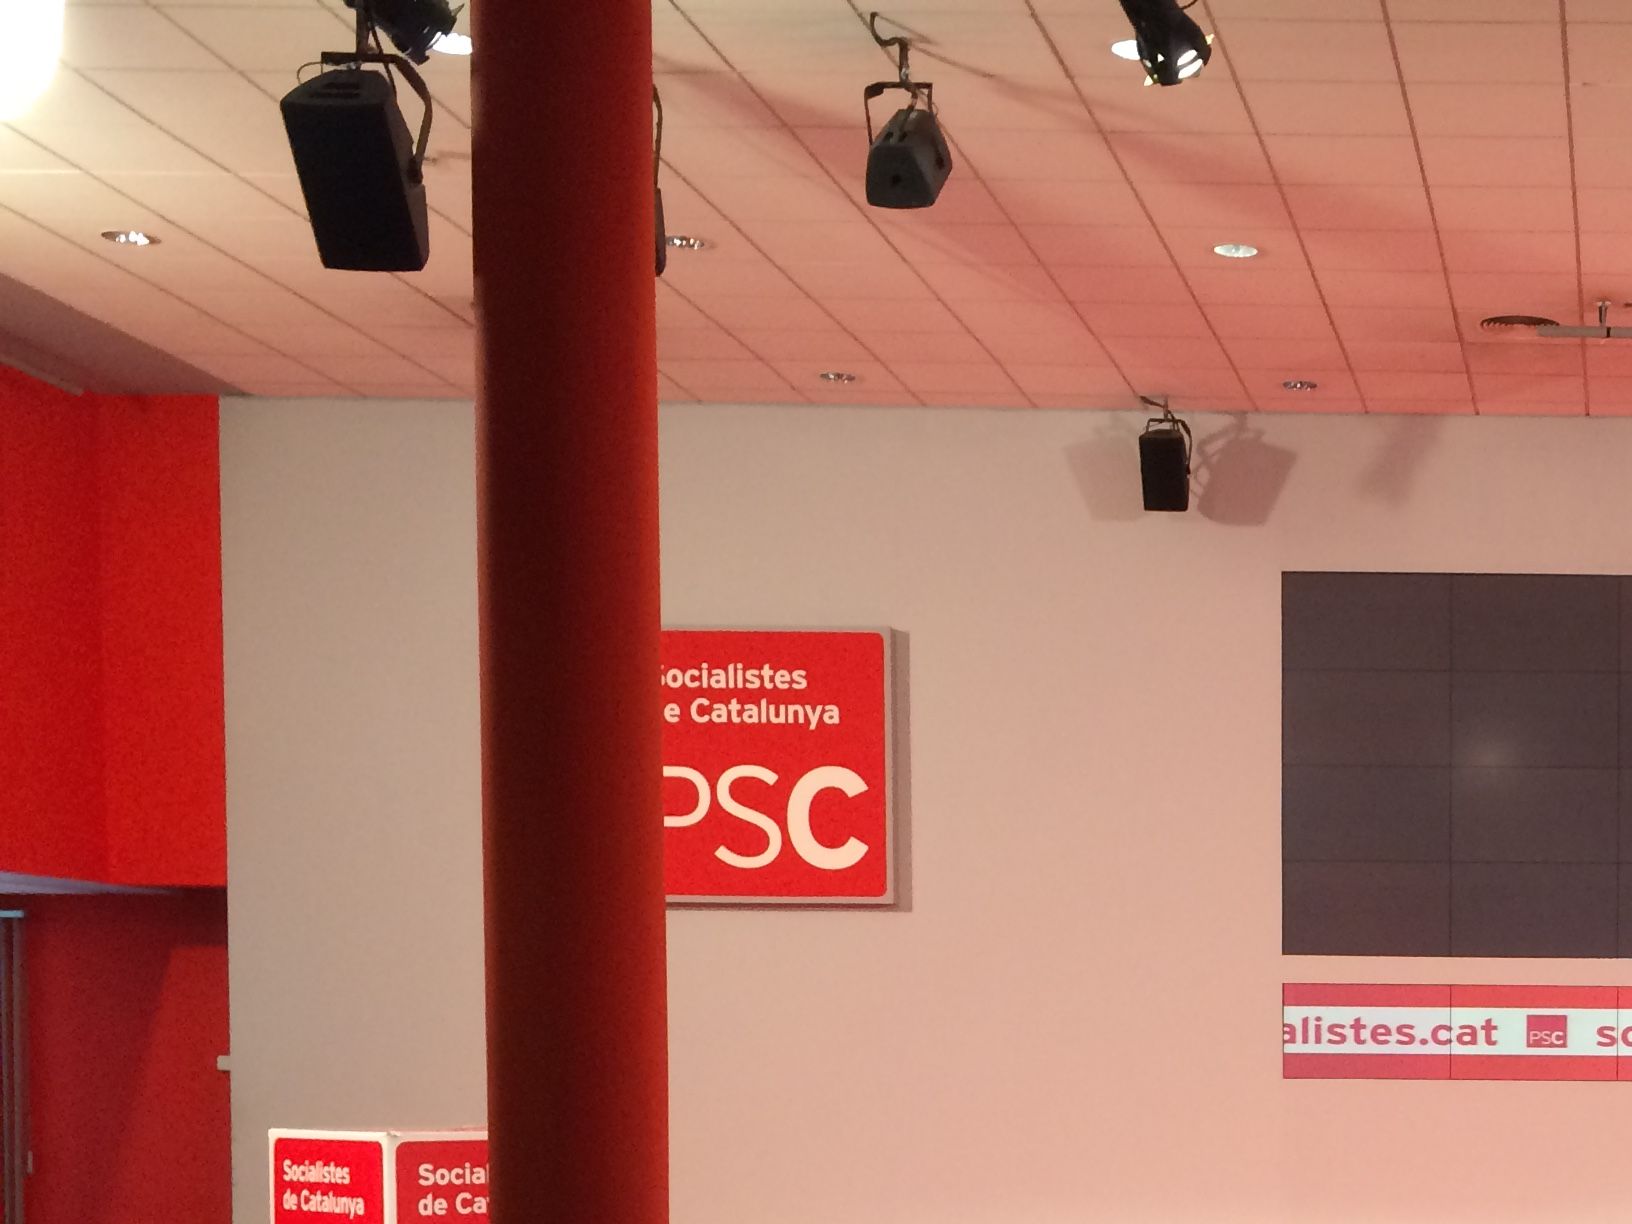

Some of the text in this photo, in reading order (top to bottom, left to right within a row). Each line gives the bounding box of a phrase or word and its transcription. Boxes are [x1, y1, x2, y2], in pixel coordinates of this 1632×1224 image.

[660, 662, 807, 689] ocialistes
[690, 697, 840, 730] Catalunya
[1529, 1030, 1565, 1045] PSC
[283, 1159, 350, 1184] Socialistes
[283, 1189, 365, 1219] de Catalunya
[418, 1193, 448, 1216] de
